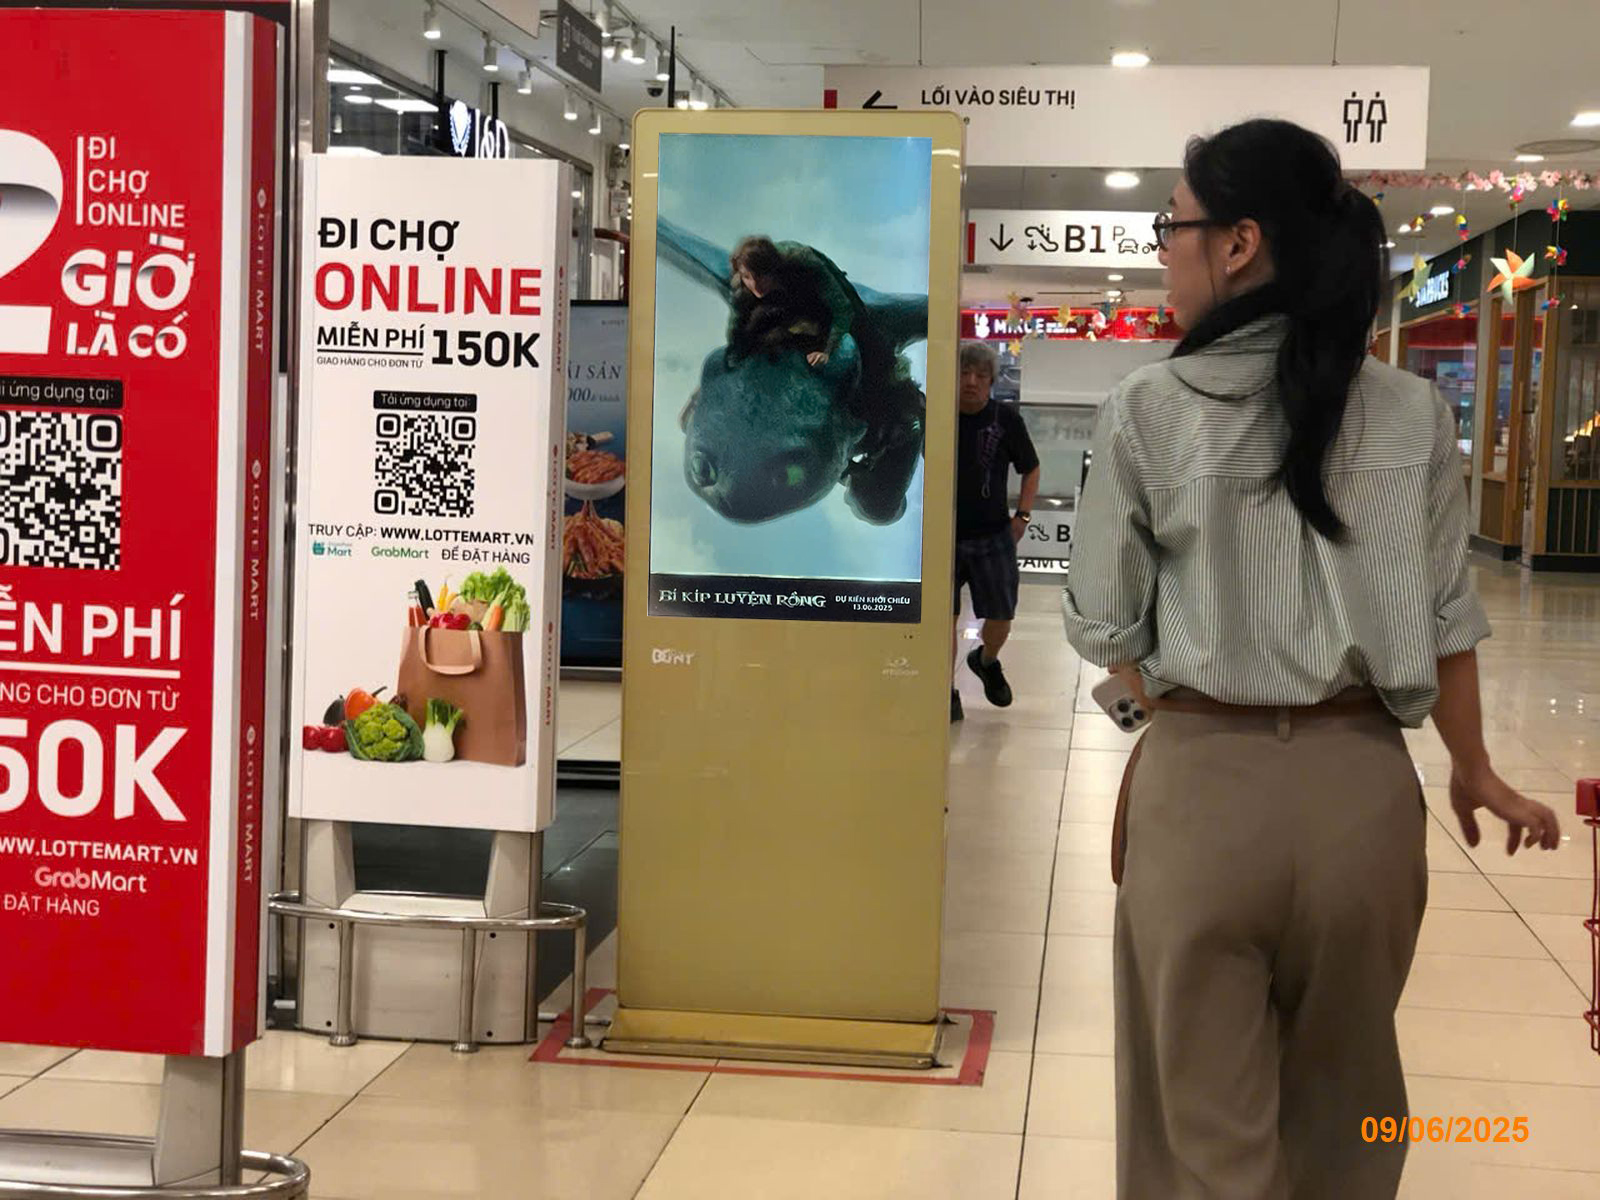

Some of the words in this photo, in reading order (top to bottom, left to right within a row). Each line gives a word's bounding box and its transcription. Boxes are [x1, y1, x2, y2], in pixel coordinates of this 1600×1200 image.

[921, 85, 950, 105] LỐI
[955, 85, 995, 106] VÀO
[999, 86, 1040, 106] SIÊU
[1044, 90, 1075, 109] THỊ
[87, 136, 116, 160] ĐI
[88, 170, 149, 199] CHỢ
[88, 203, 185, 228] ONLINE
[317, 217, 358, 250] ĐI
[370, 218, 460, 261] CHỢ
[1064, 224, 1106, 254] B1
[314, 262, 542, 316] ONLINE
[254, 289, 266, 353] MART
[66, 310, 118, 356] LÀ
[128, 311, 188, 359] CÓ
[317, 322, 378, 348] MIỄN
[385, 323, 426, 349] PHÍ
[432, 329, 541, 369] 150K
[316, 356, 339, 366] GIAO
[367, 357, 387, 368] CHO
[9, 380, 40, 400] ứng
[44, 382, 85, 403] dụng
[423, 395, 451, 409] dụng
[308, 523, 343, 536] TRUY
[346, 523, 377, 540] CẬP:
[380, 526, 534, 545] WWW.LOTTEMART.VN
[327, 546, 352, 557] Mart
[371, 546, 429, 559] GrabMart
[462, 548, 490, 564] ĐẶT
[492, 549, 530, 564] HÀNG
[249, 559, 260, 620] MART
[659, 588, 677, 602] BÍ
[681, 589, 711, 603] KÍP
[714, 590, 772, 606] LUYỆN
[776, 591, 826, 608] RỒNG
[887, 595, 911, 605] CHIẾU
[853, 604, 893, 612] 13.06.2025
[83, 593, 185, 661] PHÍ
[0, 682, 31, 703] NG
[37, 684, 85, 706] CHO
[90, 687, 141, 710] ĐƠN
[147, 685, 180, 712] TỪ
[0, 836, 198, 865] WW.LOTTEMART.VN
[34, 866, 147, 893] GrabMart
[3, 892, 42, 916] ĐẶT
[46, 893, 100, 917] HÀNG
